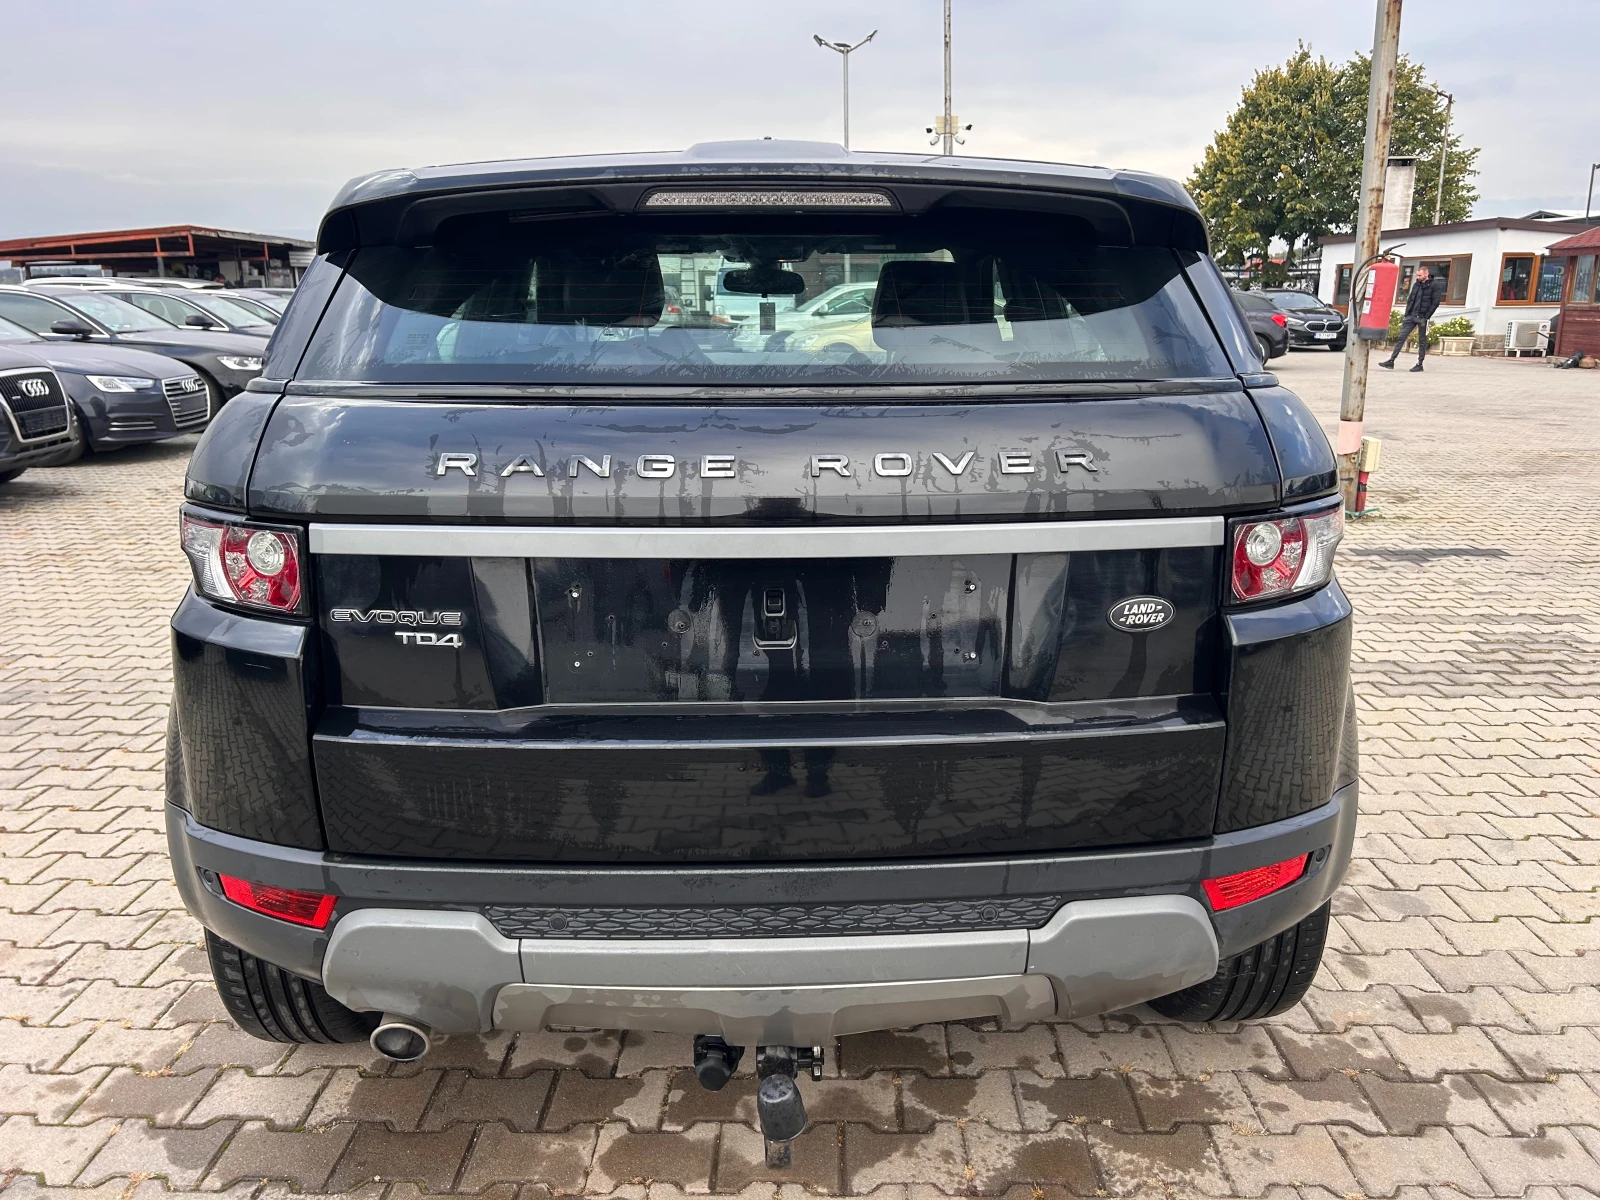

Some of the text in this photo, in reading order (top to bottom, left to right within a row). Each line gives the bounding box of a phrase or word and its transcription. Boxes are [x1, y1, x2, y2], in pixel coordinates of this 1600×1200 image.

[436, 450, 1098, 479] RANGE ROVER
[330, 608, 462, 626] EVOQUE
[394, 631, 463, 648] TD4
